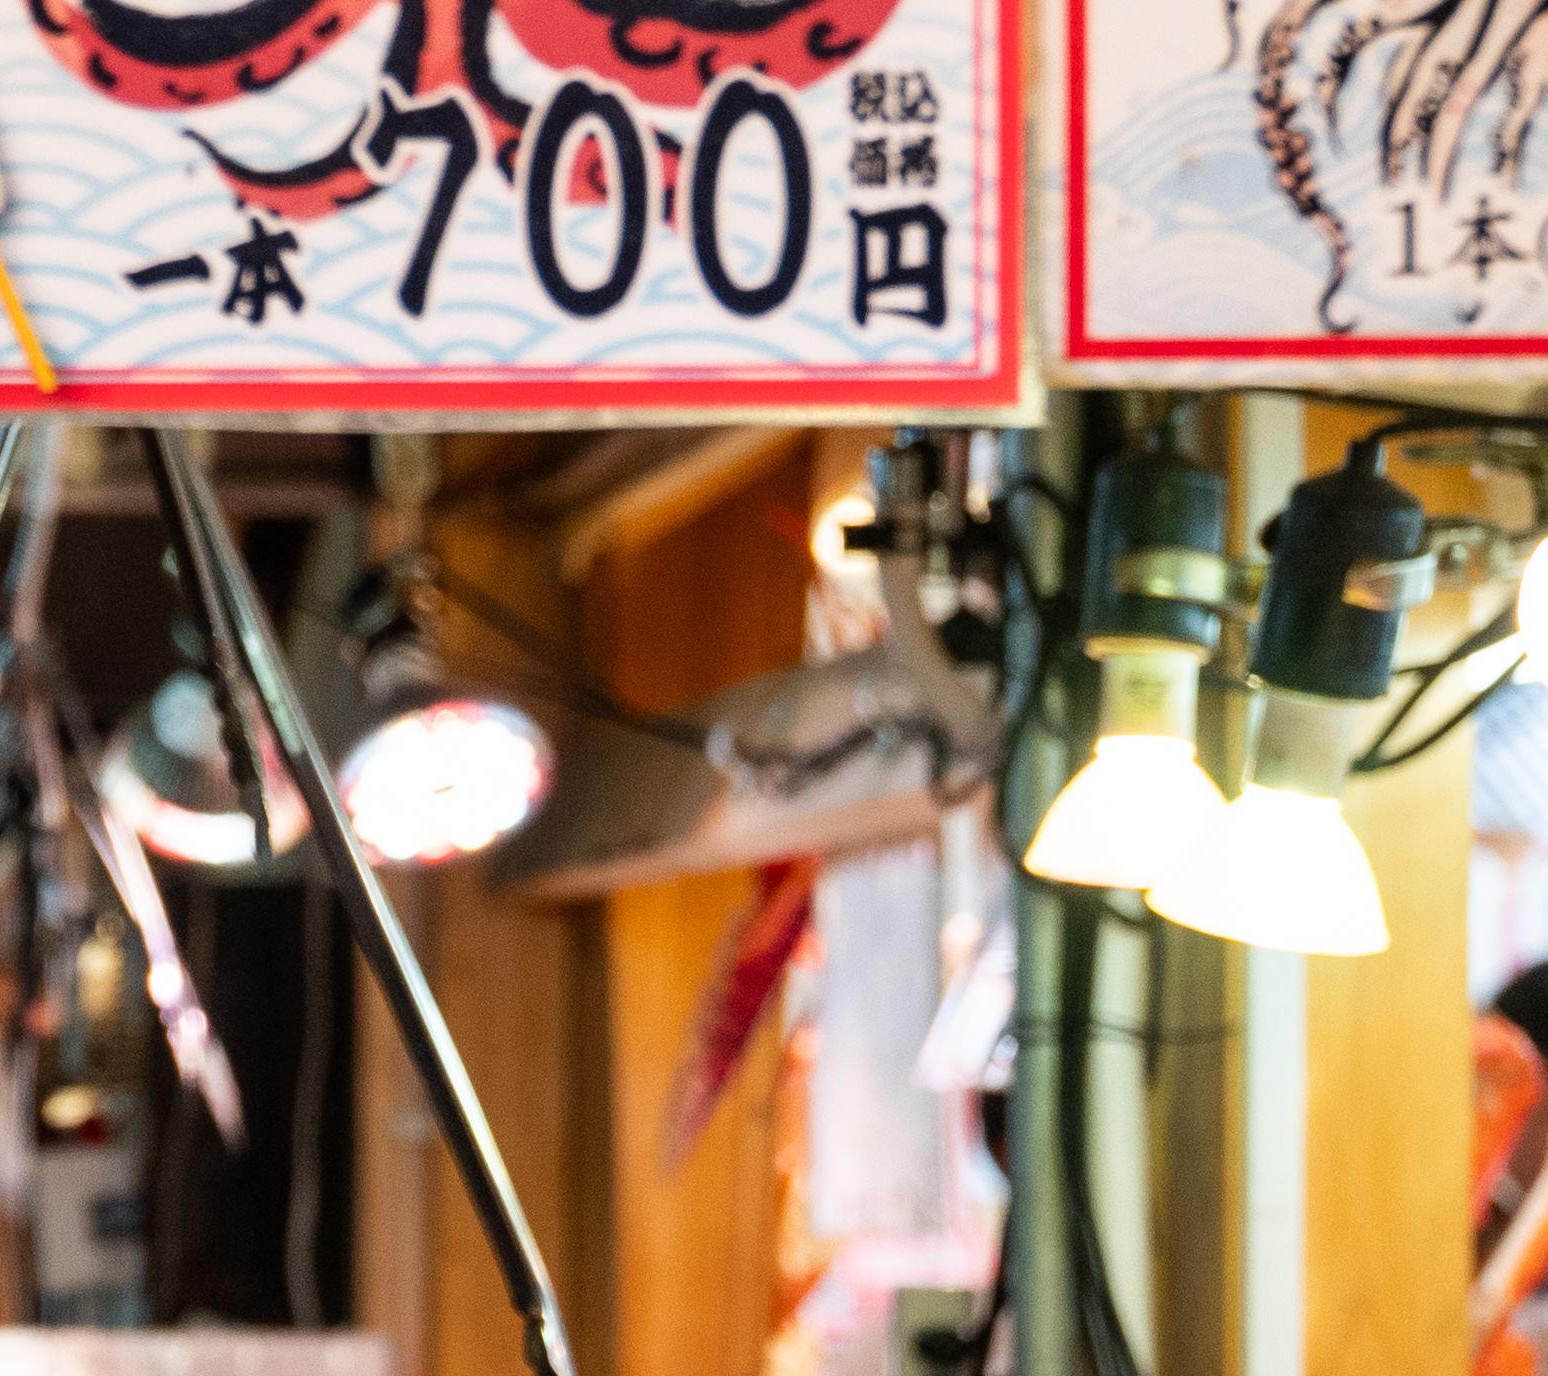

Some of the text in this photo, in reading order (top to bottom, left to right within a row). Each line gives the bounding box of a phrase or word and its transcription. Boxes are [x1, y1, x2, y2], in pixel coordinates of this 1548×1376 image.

[123, 76, 949, 328] 一本 700 円
